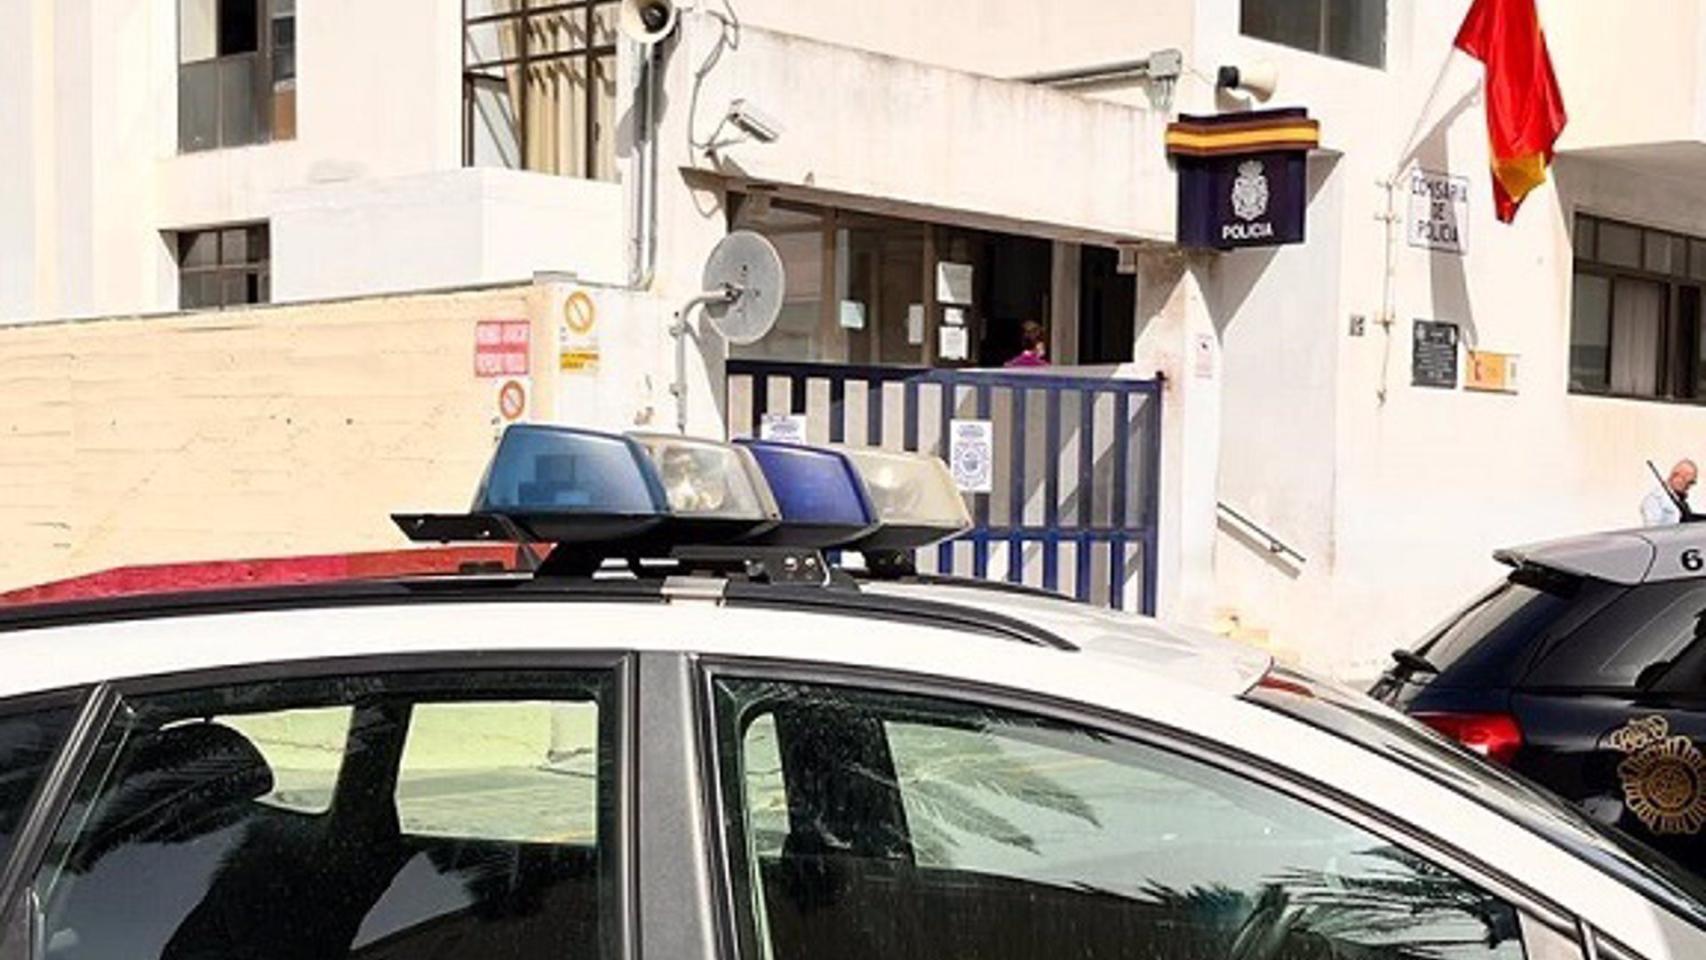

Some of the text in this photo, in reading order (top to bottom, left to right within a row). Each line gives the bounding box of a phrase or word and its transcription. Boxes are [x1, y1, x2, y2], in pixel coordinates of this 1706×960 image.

[1431, 201, 1446, 221] DE
[1222, 223, 1273, 240] POLICIA
[1681, 549, 1704, 572] 6
